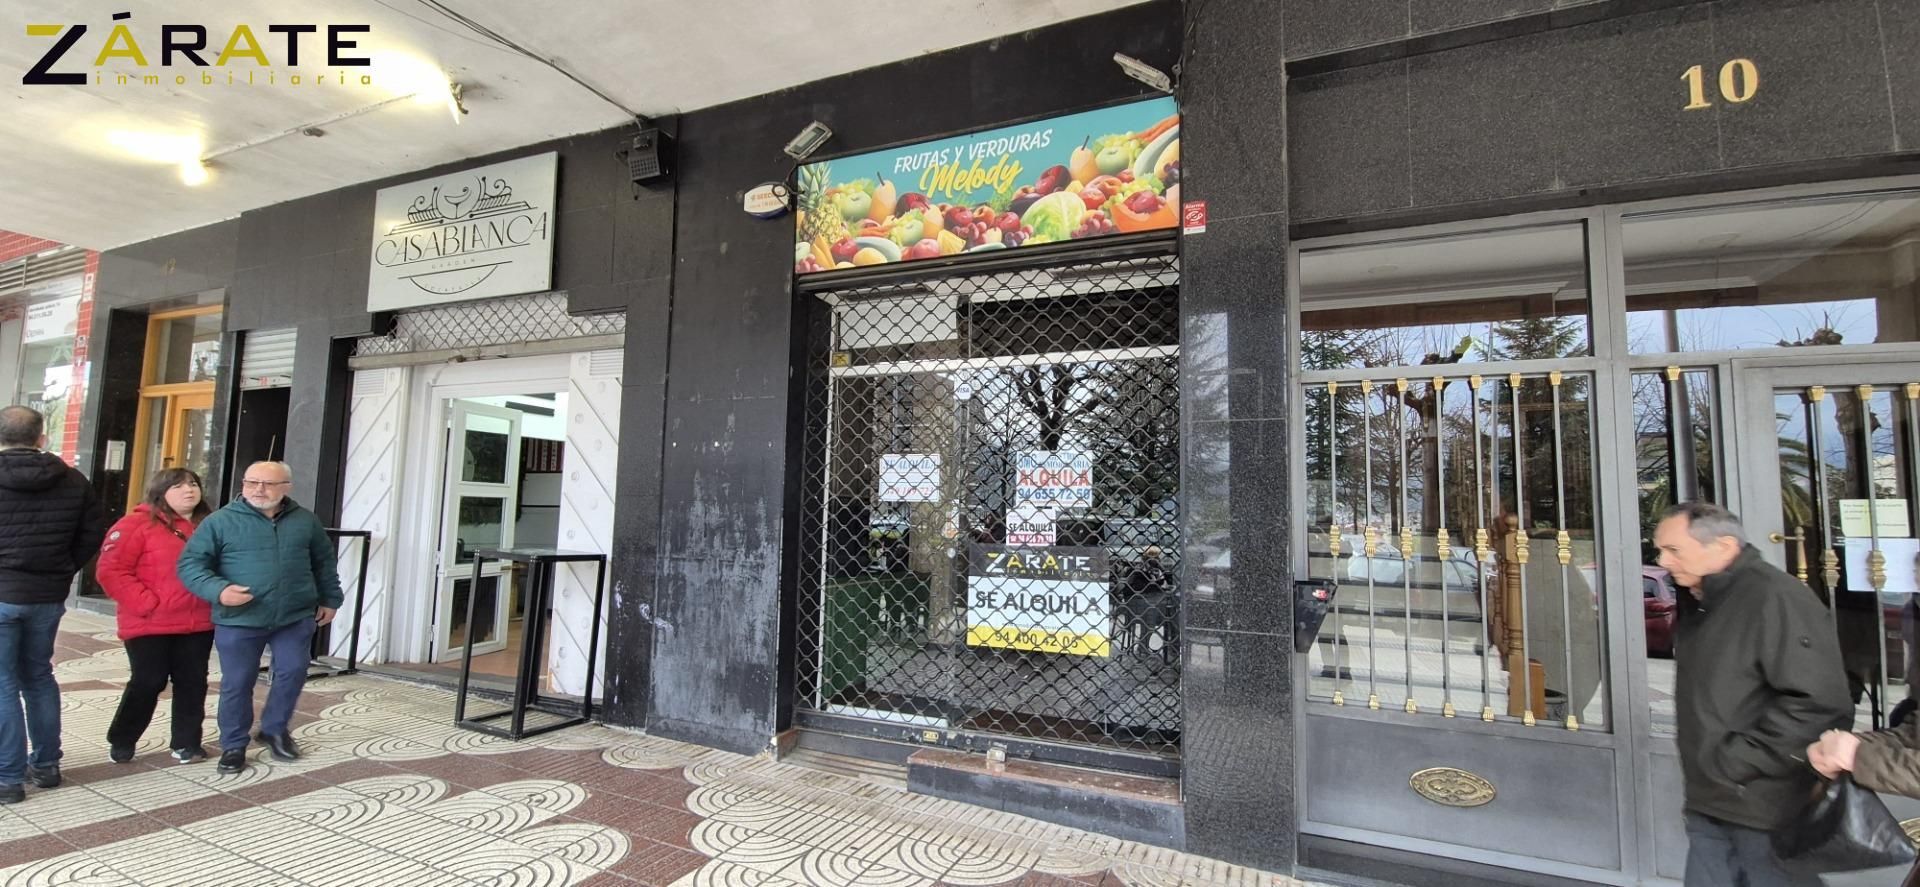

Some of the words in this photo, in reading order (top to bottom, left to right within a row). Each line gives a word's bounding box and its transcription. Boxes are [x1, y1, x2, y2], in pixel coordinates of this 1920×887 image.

[1680, 58, 1758, 111] 10
[894, 148, 949, 174] FRUTAS
[955, 145, 965, 161] Y
[969, 129, 1053, 160] VERDURAS
[919, 153, 1023, 198] Melody
[1020, 469, 1089, 486] ALQUILA
[1018, 488, 1030, 499] 94
[1019, 522, 1053, 532] ALQUILA
[976, 591, 998, 609] SE
[1003, 593, 1101, 615] ALQUILA
